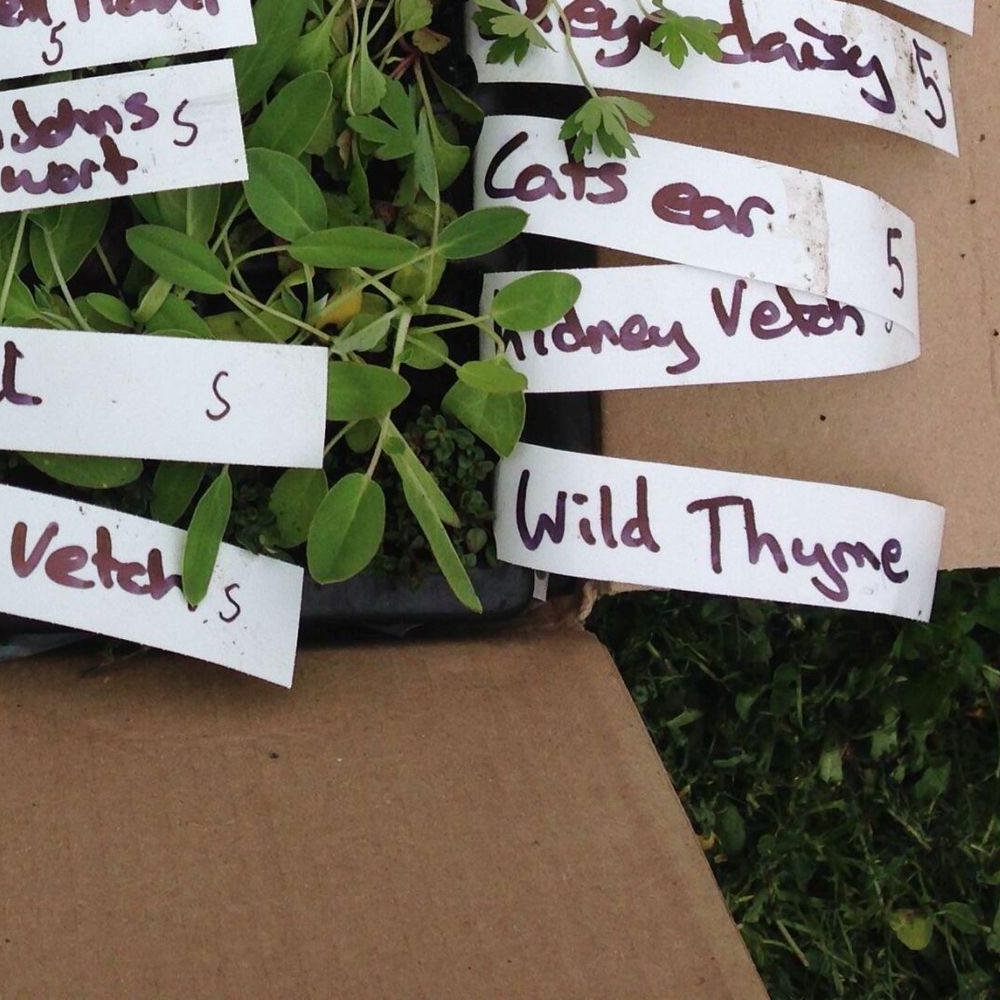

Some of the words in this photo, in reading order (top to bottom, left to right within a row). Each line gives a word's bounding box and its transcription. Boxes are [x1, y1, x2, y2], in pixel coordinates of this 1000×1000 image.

[1, 134, 138, 195] wort
[484, 131, 629, 204] Cats
[652, 182, 775, 237] ear
[516, 469, 660, 553] Wild
[687, 496, 909, 601] Thyme
